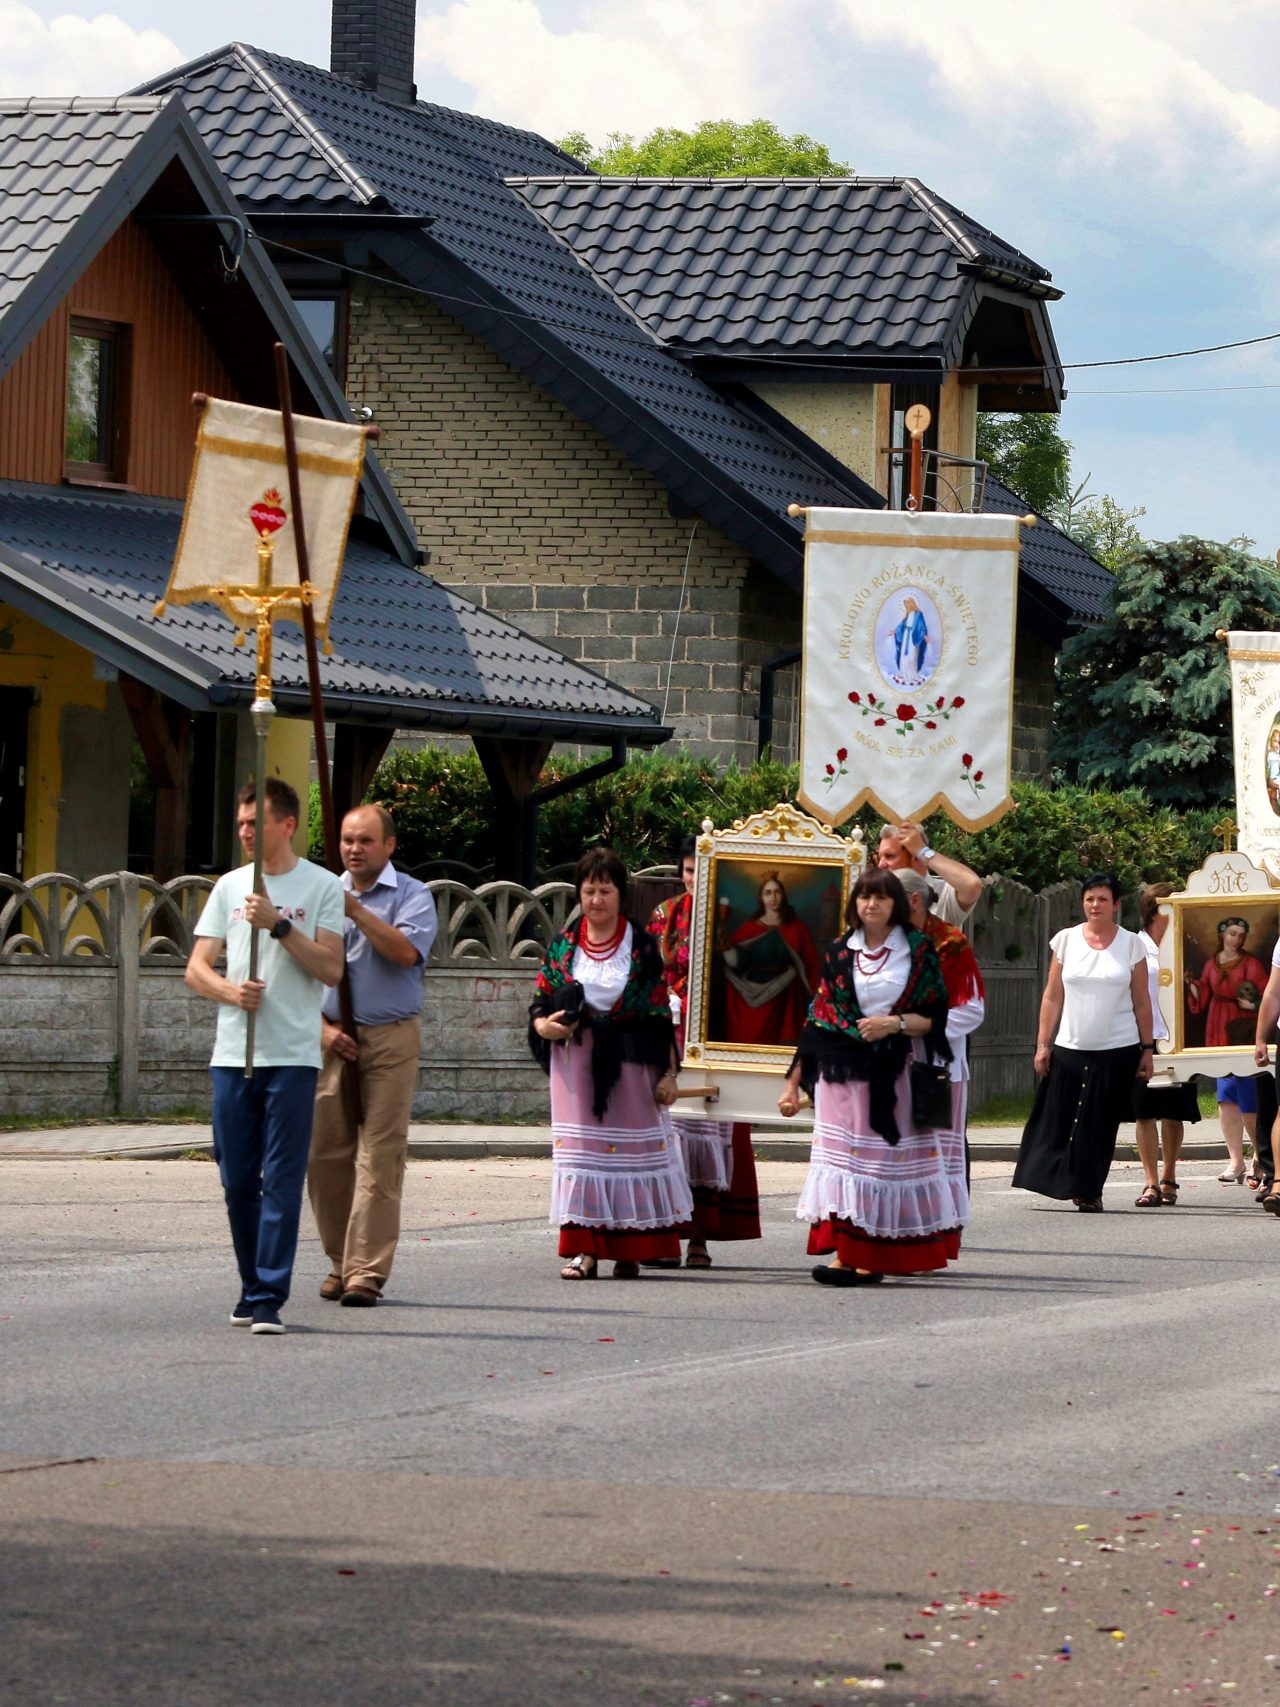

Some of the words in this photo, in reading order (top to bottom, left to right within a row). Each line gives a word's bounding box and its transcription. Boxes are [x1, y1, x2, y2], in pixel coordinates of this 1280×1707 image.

[839, 587, 872, 661] KRÓLOWO
[871, 562, 945, 590] RÓŻAŃCA
[947, 584, 979, 667] ŚWIĘTEGO
[908, 747, 925, 757] ZA
